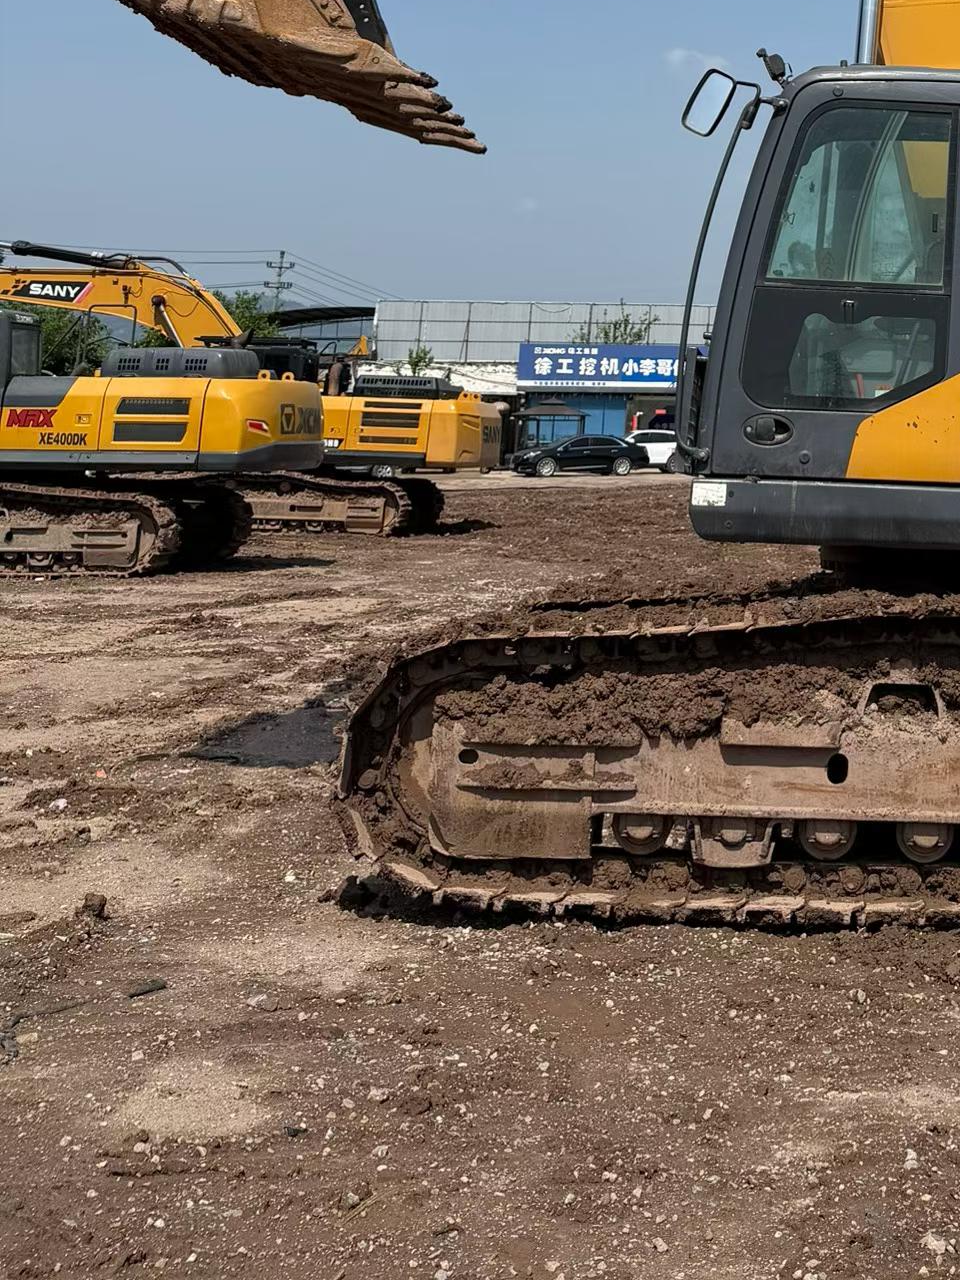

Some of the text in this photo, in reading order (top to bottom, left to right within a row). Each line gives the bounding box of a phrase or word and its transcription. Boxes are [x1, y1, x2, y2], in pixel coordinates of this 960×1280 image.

[29, 283, 80, 298] SANY
[6, 409, 58, 428] MAX
[39, 432, 88, 446] XE400DK
